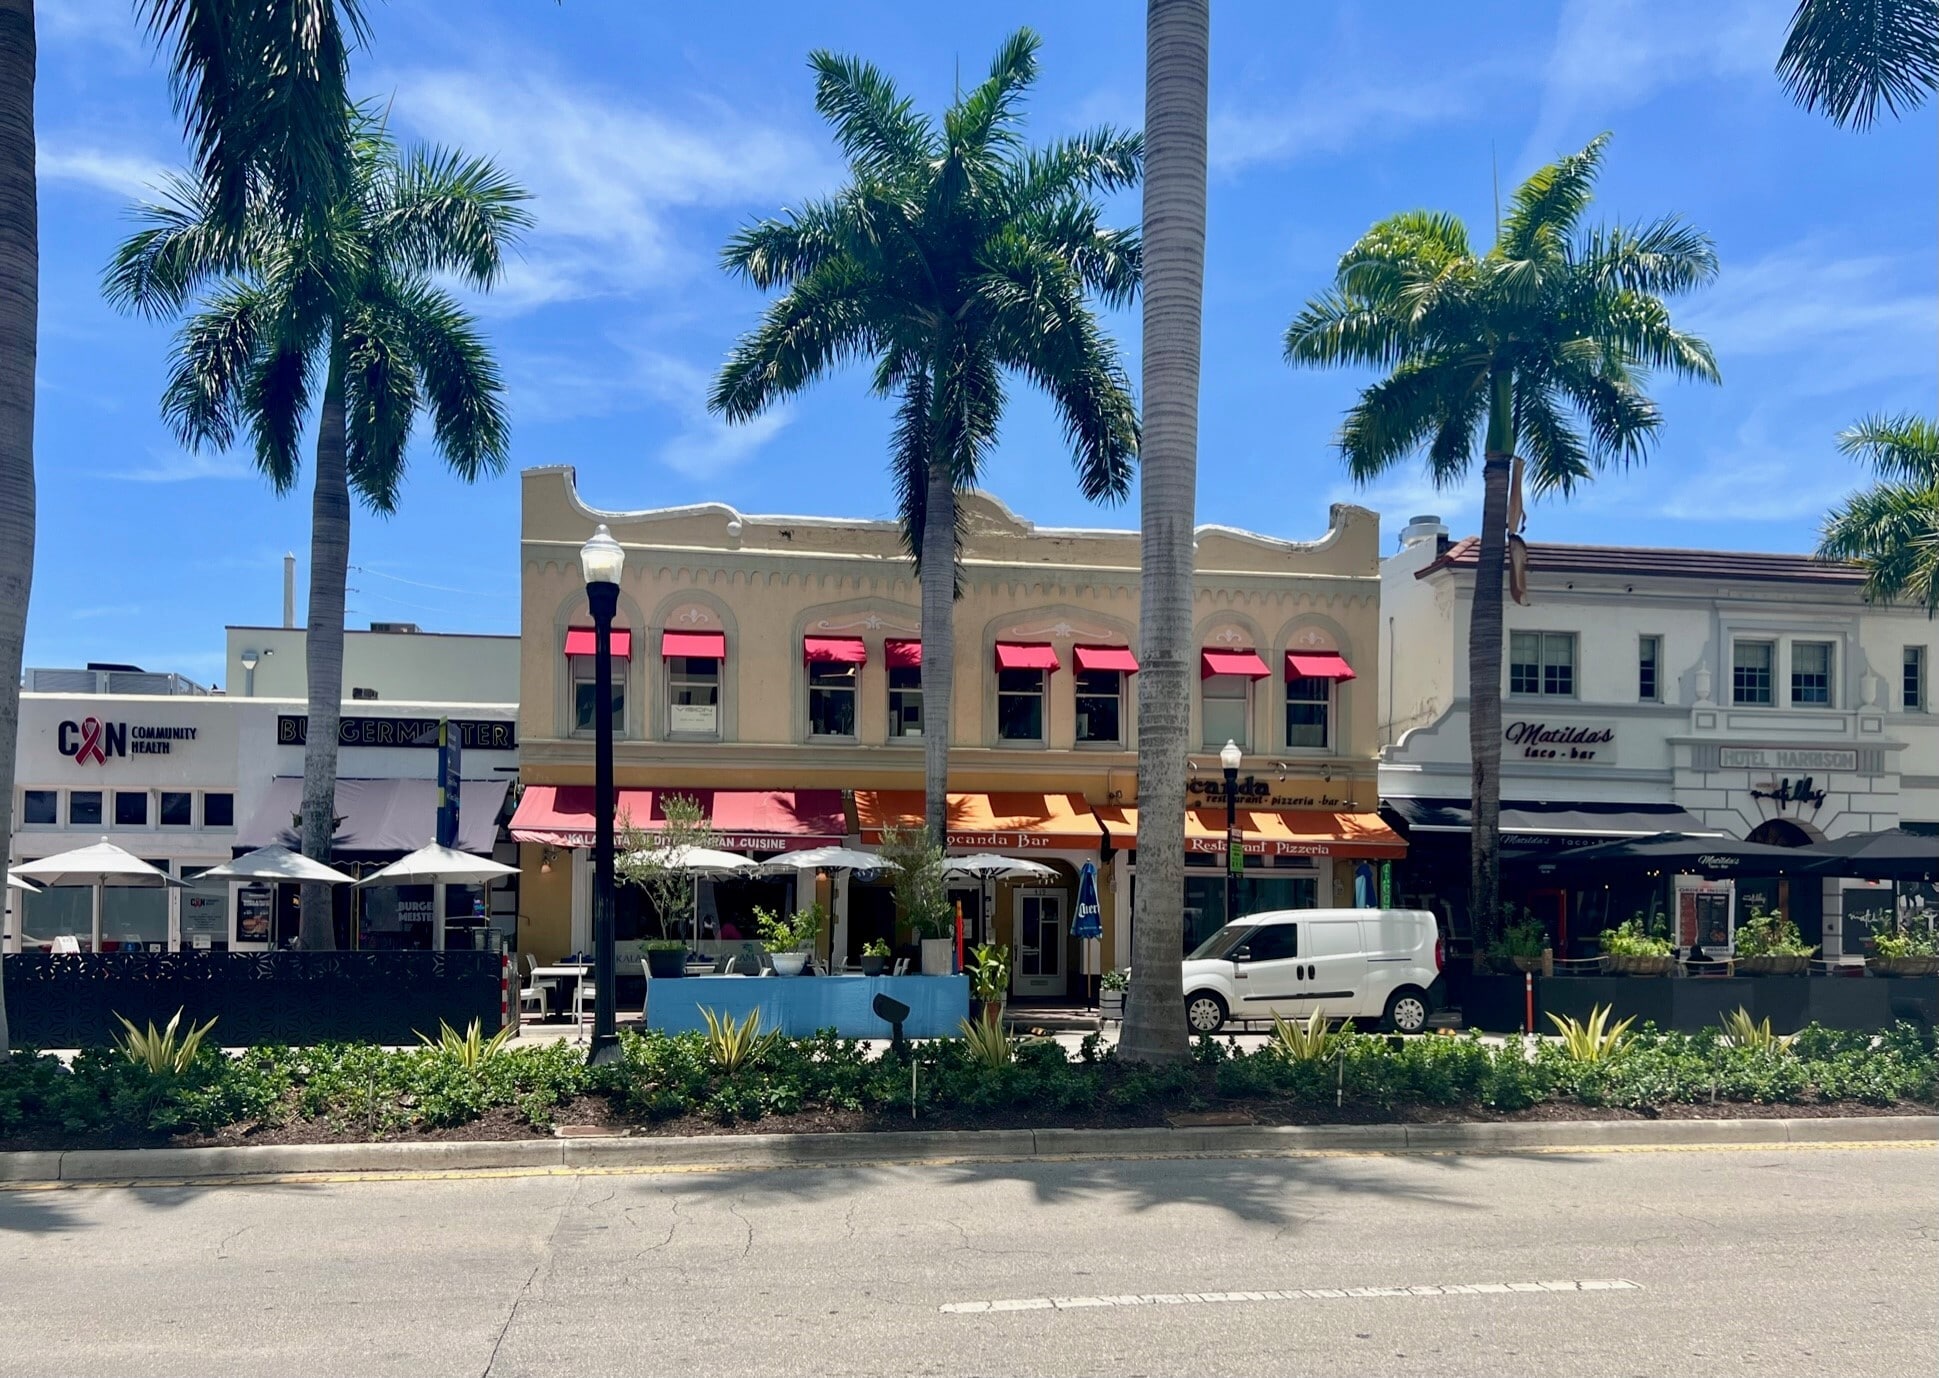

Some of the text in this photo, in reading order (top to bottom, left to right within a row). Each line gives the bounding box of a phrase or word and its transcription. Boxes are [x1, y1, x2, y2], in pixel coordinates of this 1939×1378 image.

[131, 726, 197, 740] COMMUNITY
[131, 741, 170, 754] HEALTH
[1525, 746, 1596, 759] taco bar
[1724, 751, 1854, 769] HOTEL HARRISON
[1206, 795, 1263, 804] resturant
[1271, 796, 1313, 806] pizzeria
[740, 838, 786, 849] CUISINE
[946, 834, 1050, 848] ocanda Bar
[1276, 842, 1329, 855] Pizzeria
[398, 901, 434, 912] BURGE
[398, 912, 434, 922] MEISTE
